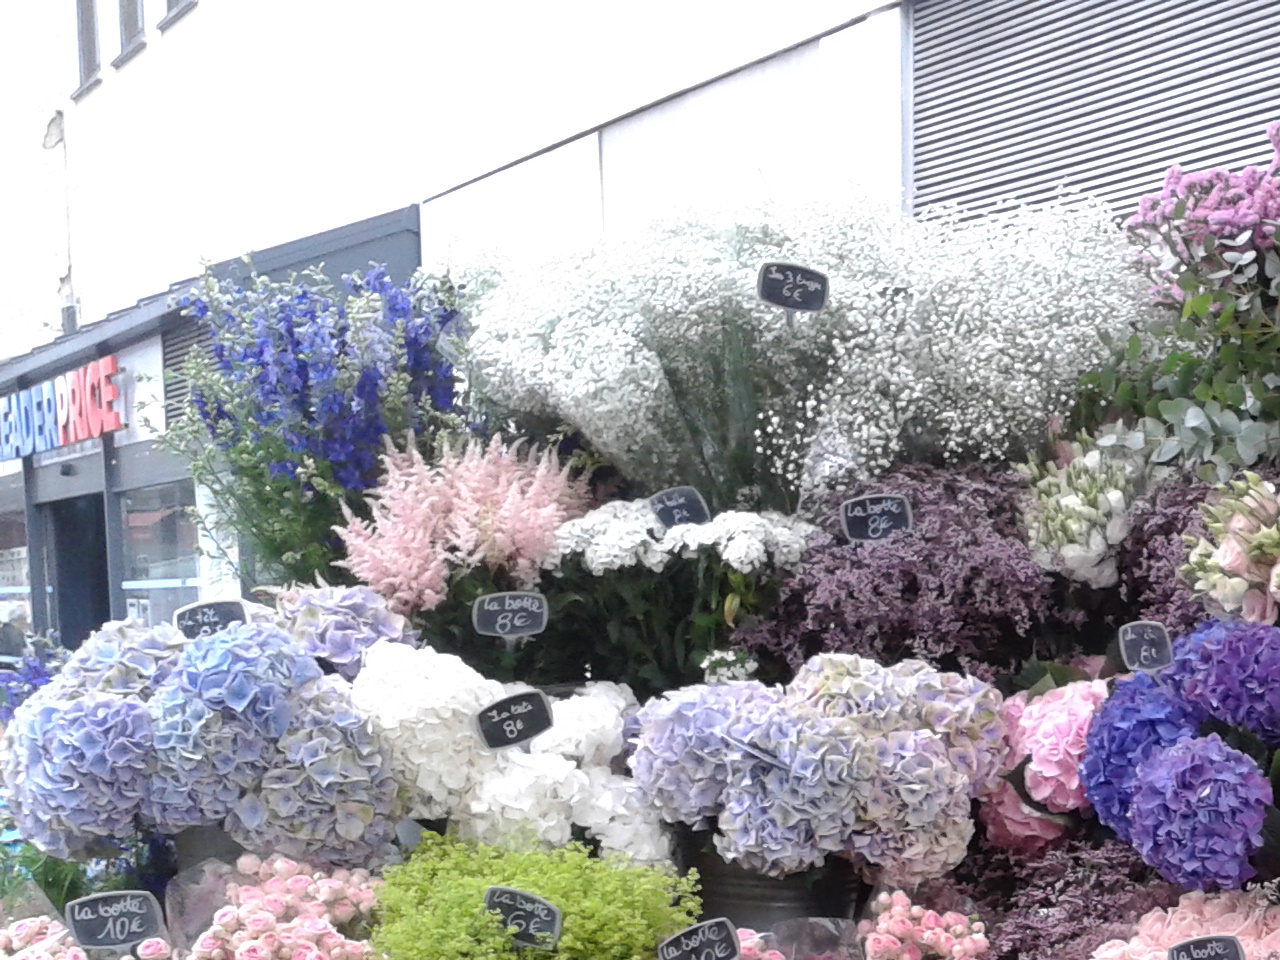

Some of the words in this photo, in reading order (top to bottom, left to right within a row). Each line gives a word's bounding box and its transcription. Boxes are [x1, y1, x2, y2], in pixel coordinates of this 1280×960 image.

[782, 284, 803, 302] 6€
[0, 381, 59, 461] EADER
[866, 498, 903, 515] botte
[868, 514, 893, 538] 8€
[505, 595, 544, 612] botte
[495, 612, 533, 634] 8€
[503, 718, 524, 738] 8€
[99, 896, 148, 916] botte
[516, 894, 553, 921] botte
[98, 918, 148, 940] 10€
[682, 923, 728, 948] botte
[1191, 941, 1230, 957] botte
